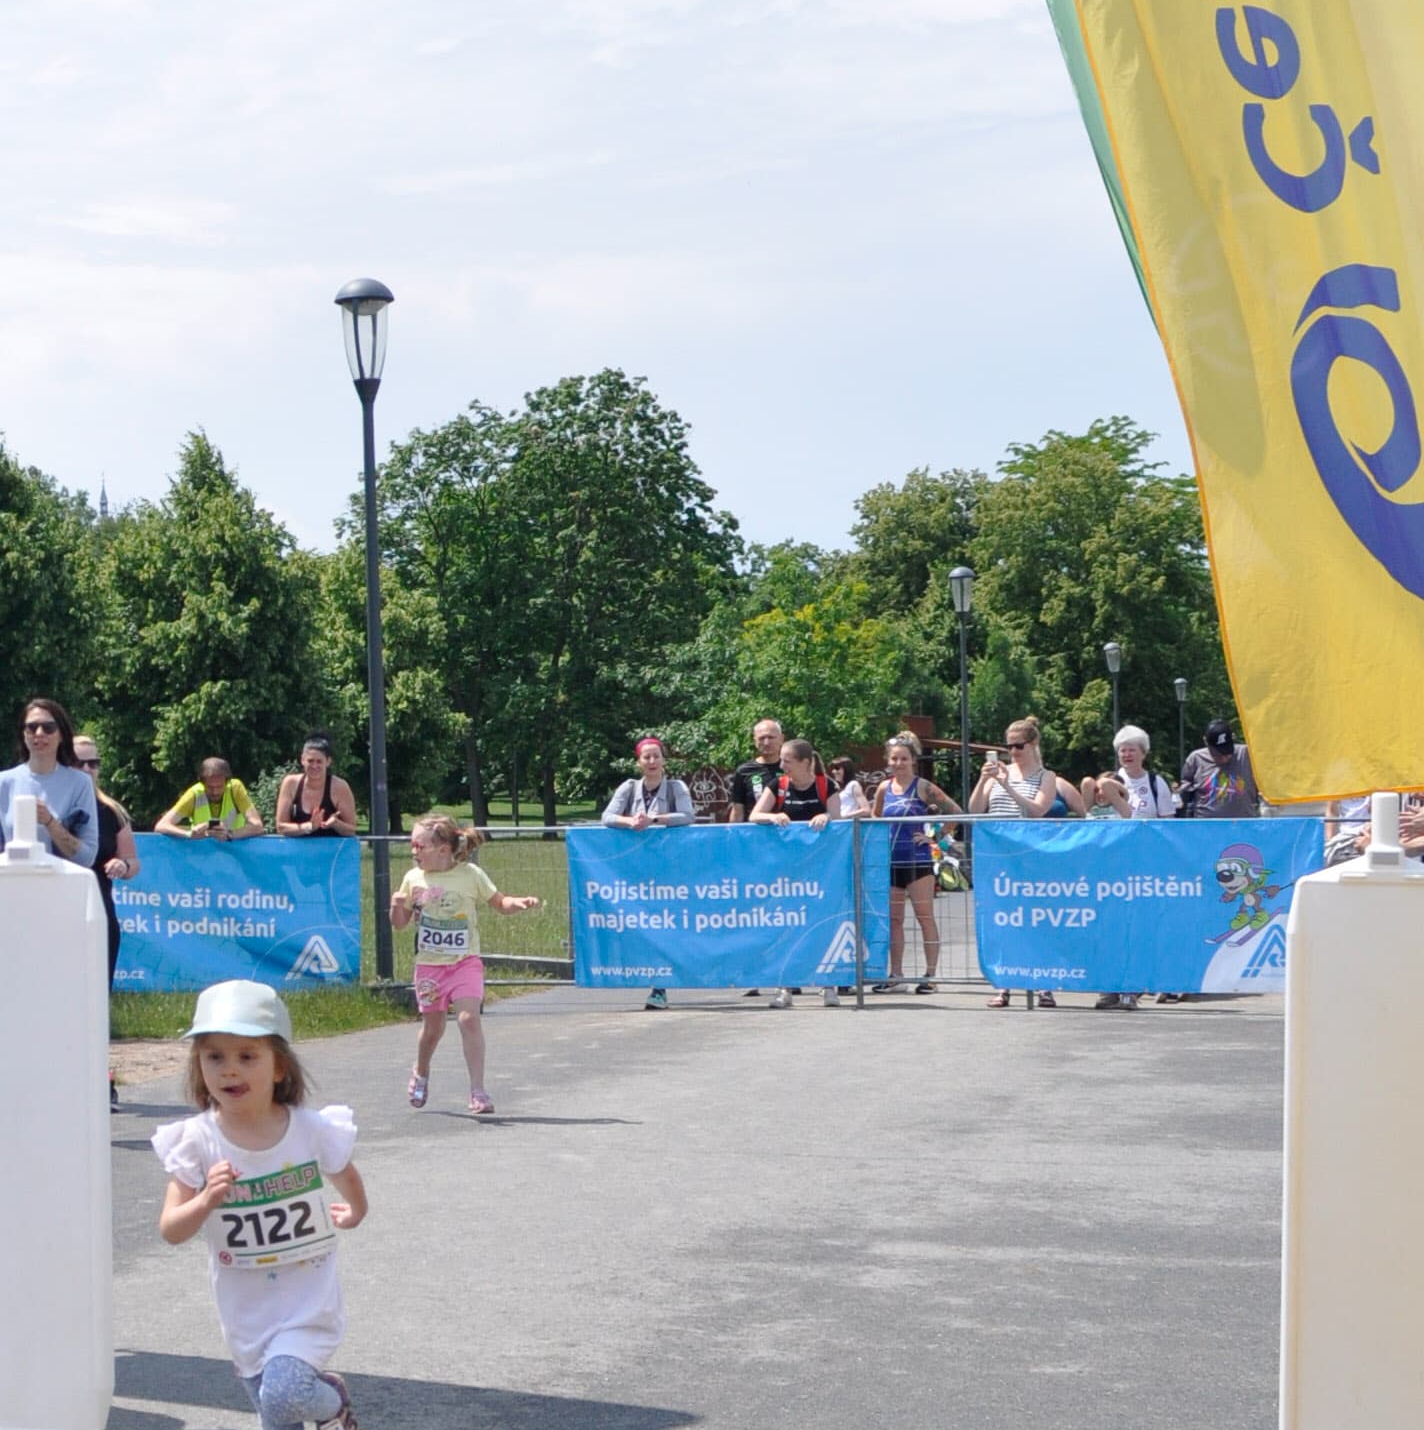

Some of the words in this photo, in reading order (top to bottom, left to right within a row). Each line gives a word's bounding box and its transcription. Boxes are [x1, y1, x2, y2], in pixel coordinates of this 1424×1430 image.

[586, 881, 689, 903] Pojistíme
[694, 879, 738, 899] vaši
[745, 878, 825, 900] rodinu,
[993, 872, 1090, 897] Úrazové
[1097, 876, 1202, 901] pojištění
[167, 889, 211, 909] vaši
[217, 889, 295, 914] rodinu,
[154, 915, 161, 934] i
[167, 918, 275, 939] podnikání
[588, 909, 677, 933] majetek
[682, 909, 689, 929] i
[695, 906, 807, 933] podnikání
[994, 907, 1023, 927] od
[1031, 908, 1097, 927] PVZP
[422, 929, 465, 947] 2046
[590, 965, 673, 978] www.pvzp.cz
[994, 964, 1087, 979] www.pvzp.cz
[264, 1165, 314, 1198] HELP
[221, 1200, 316, 1248] 2122
